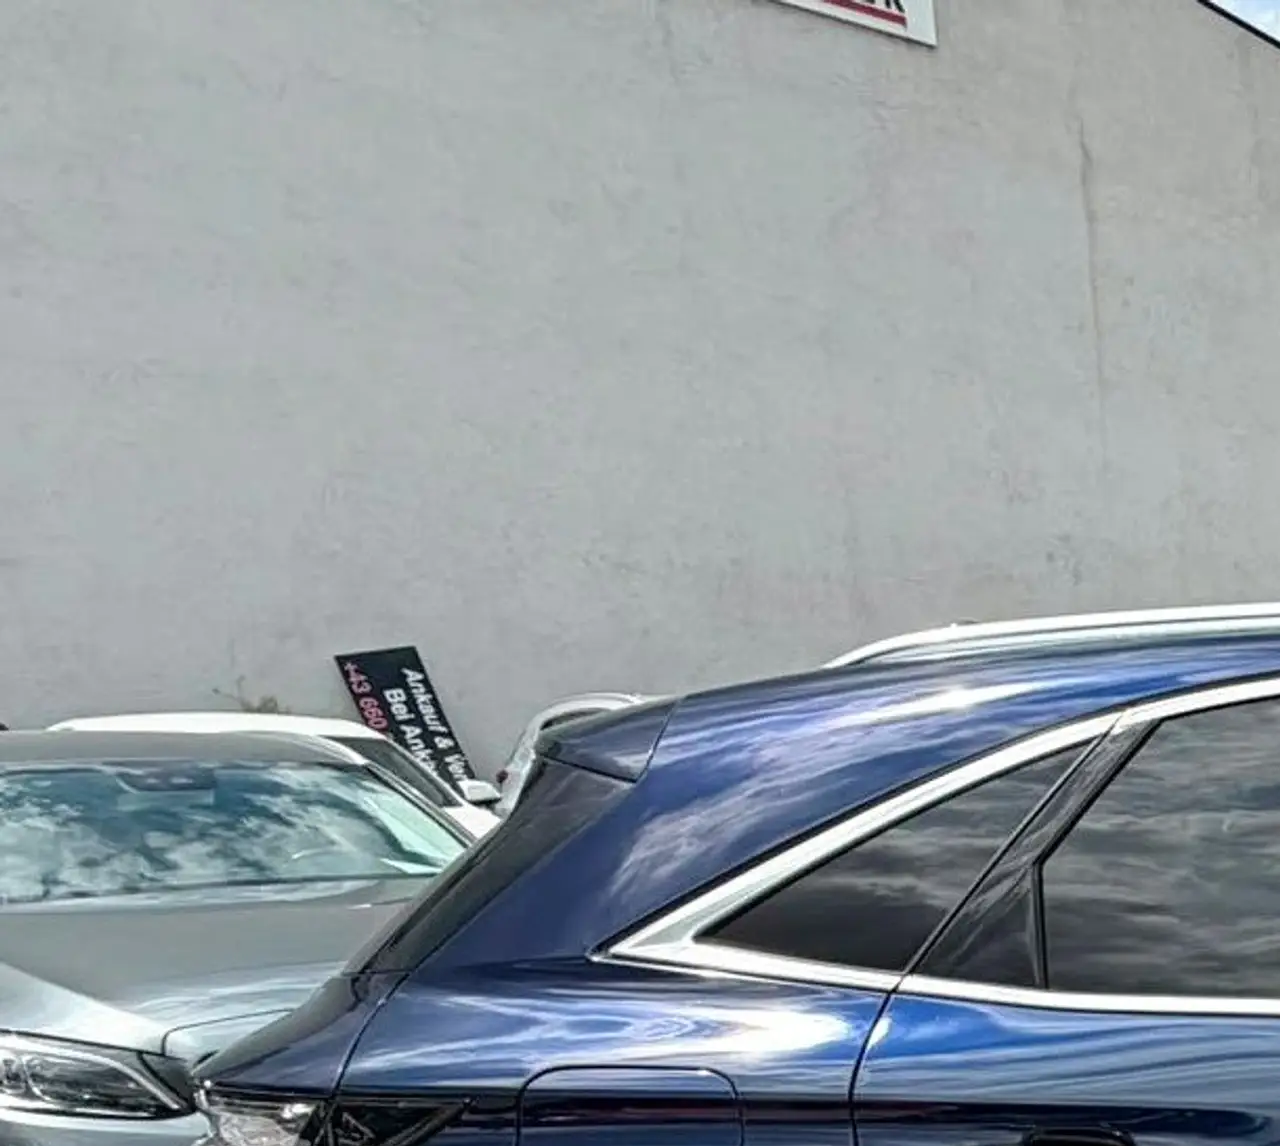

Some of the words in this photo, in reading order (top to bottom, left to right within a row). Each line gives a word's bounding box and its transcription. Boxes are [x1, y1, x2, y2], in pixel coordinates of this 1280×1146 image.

[343, 662, 373, 694] +43
[383, 688, 416, 720] Bei
[400, 668, 449, 734] Ankauf
[434, 736, 456, 749] &
